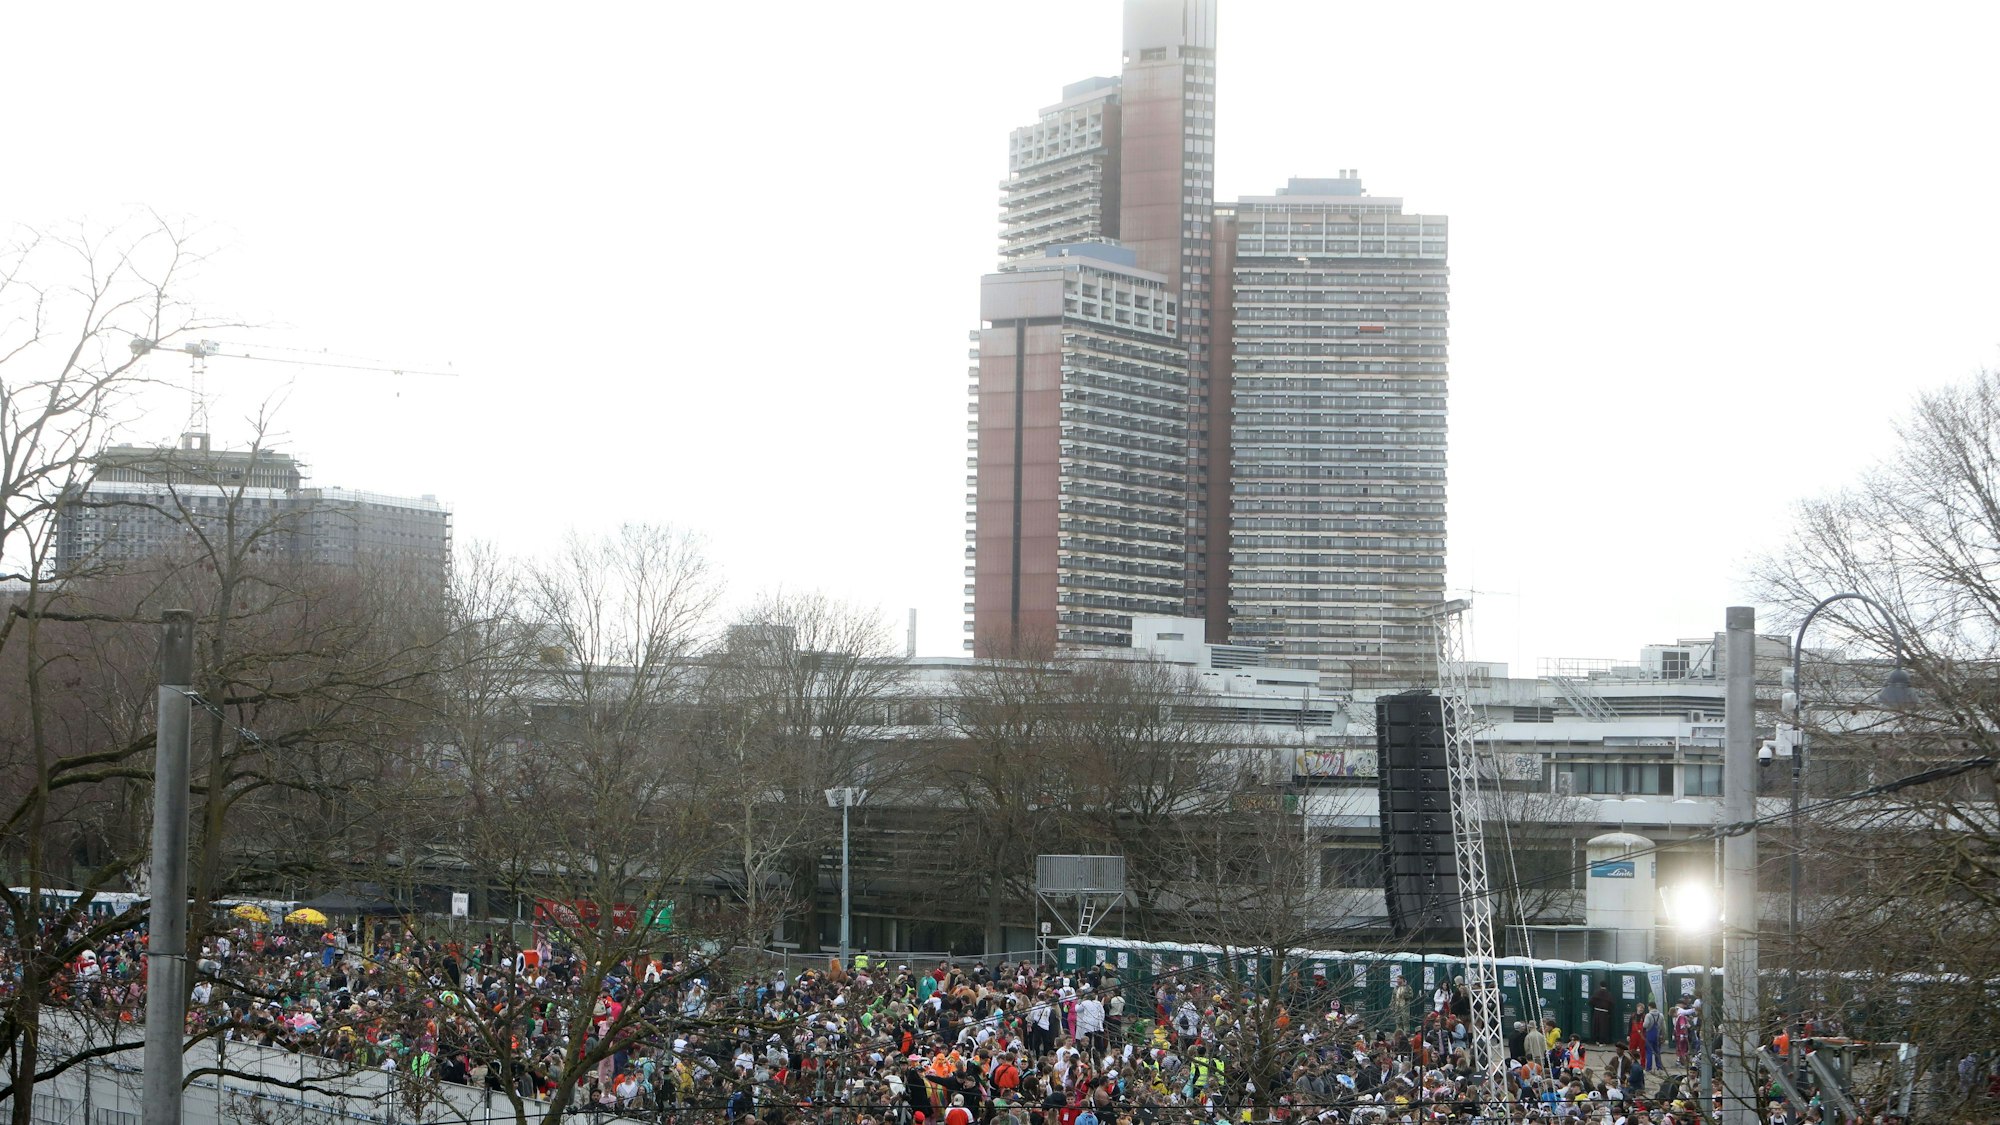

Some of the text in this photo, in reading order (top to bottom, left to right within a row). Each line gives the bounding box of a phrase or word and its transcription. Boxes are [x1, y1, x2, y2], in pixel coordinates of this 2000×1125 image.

[1607, 867, 1633, 877] Linde
[1543, 974, 1556, 983] DIXI
[1623, 976, 1635, 986] DIXI
[1681, 979, 1695, 989] DIXI
